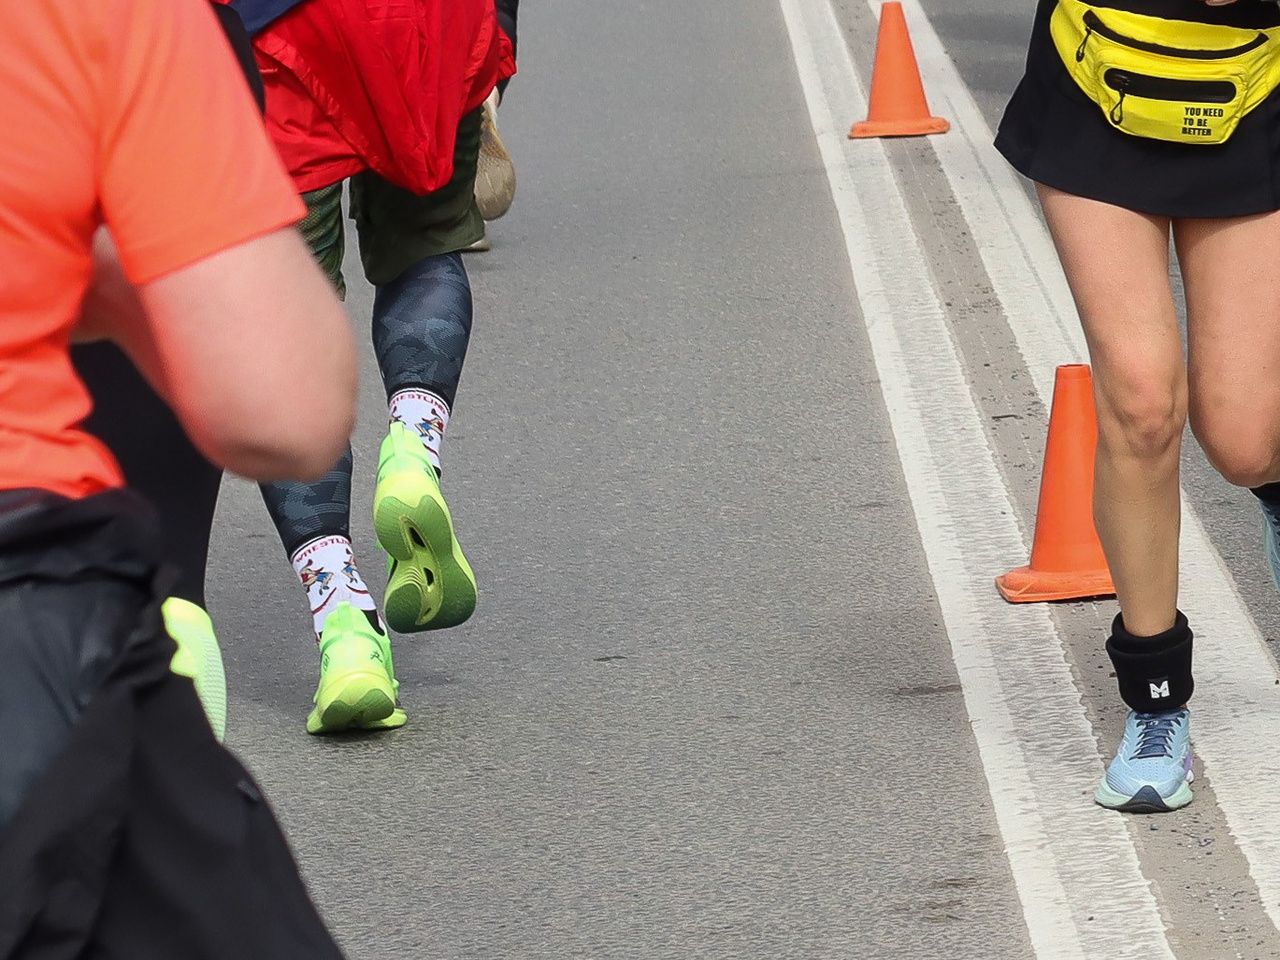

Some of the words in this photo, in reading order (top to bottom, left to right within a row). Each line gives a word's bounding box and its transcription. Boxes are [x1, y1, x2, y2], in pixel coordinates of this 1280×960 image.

[1185, 107, 1201, 116] YOU
[1203, 108, 1224, 117] NEED
[1184, 118, 1194, 126] TO
[1197, 119, 1208, 127] BE
[1182, 127, 1212, 136] BETTER
